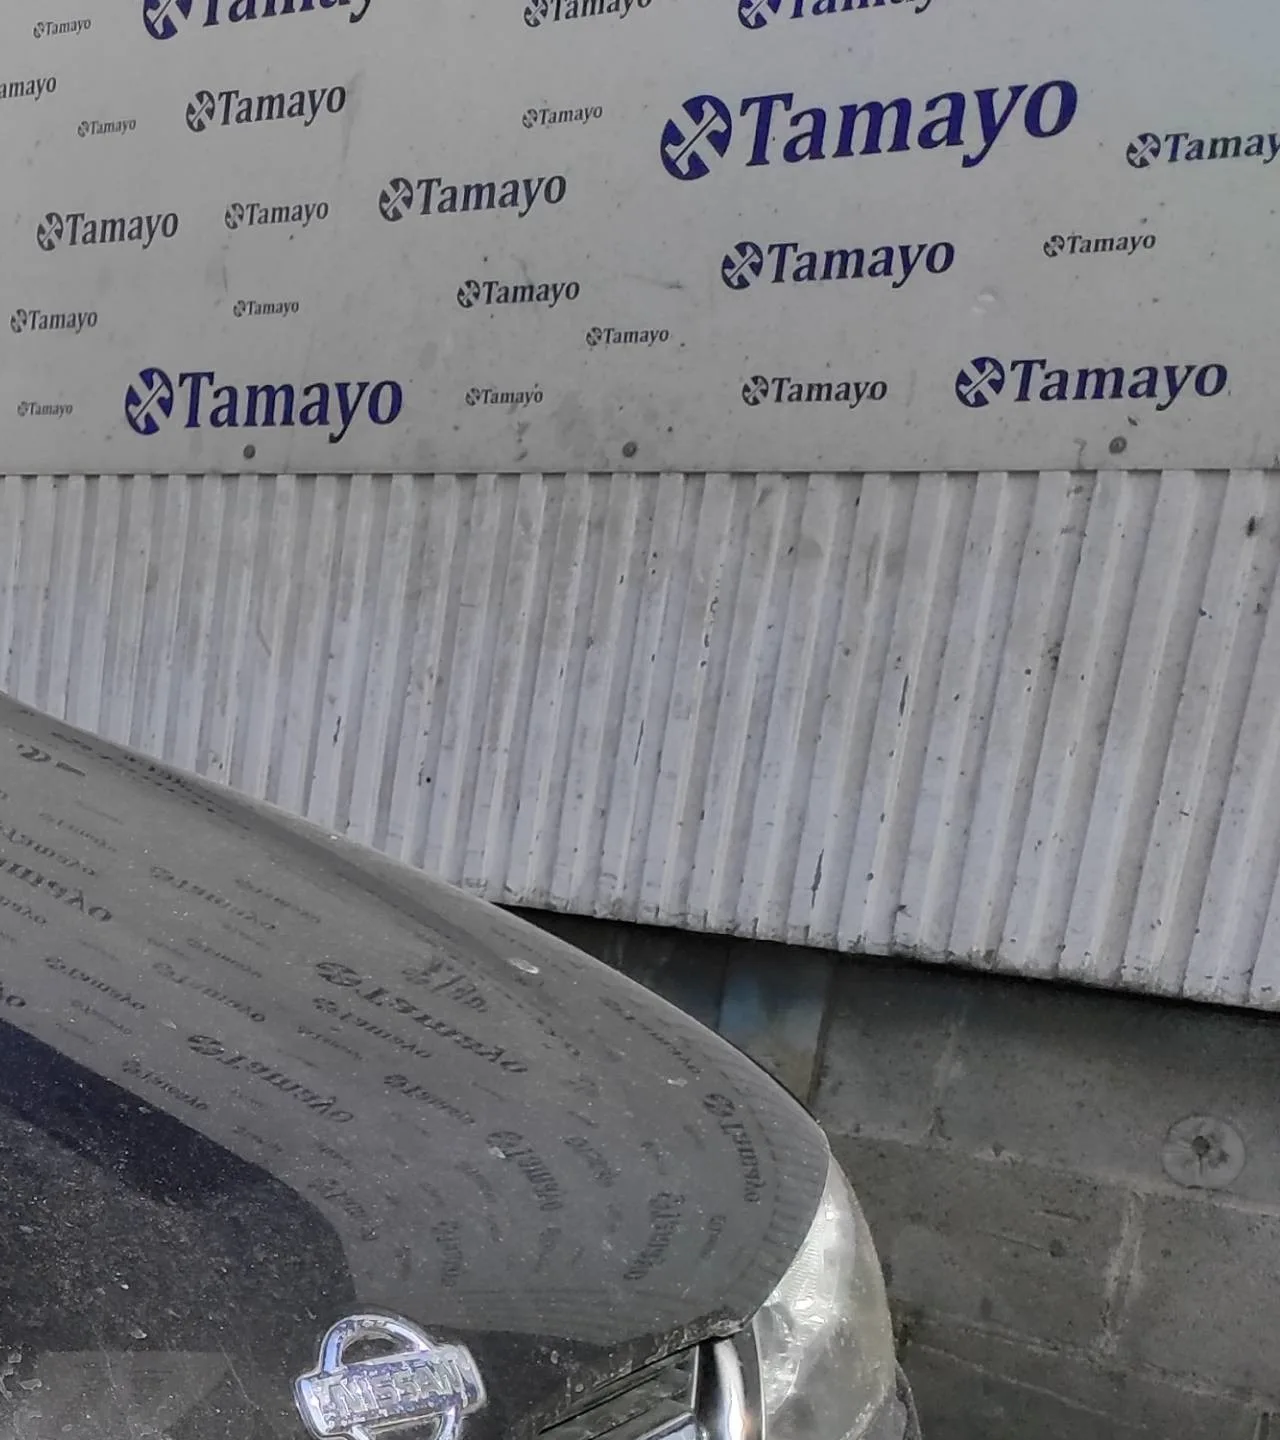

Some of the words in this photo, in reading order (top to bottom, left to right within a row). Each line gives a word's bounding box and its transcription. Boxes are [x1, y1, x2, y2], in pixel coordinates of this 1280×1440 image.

[46, 19, 91, 35] Tamayo
[0, 77, 56, 100] amayo
[218, 87, 346, 127] Tamayo
[538, 104, 603, 126] Tamayo
[92, 120, 136, 135] Tamayo
[740, 80, 1077, 168] Tamayo
[1165, 133, 1280, 164] Tamay
[417, 176, 566, 218] Tamayo
[246, 203, 328, 227] Tamayo
[66, 213, 178, 249] Tamayo
[1067, 231, 1157, 255] Tamayo
[768, 242, 954, 288] Tamayo
[483, 281, 579, 308] Tamayo
[28, 309, 98, 332] Tamayo
[244, 301, 299, 316] Tamayo
[604, 328, 669, 346] Tamayo
[479, 386, 544, 406] Tamayo
[769, 378, 888, 408] Tamayo
[1010, 359, 1227, 411] Tamayo
[29, 402, 73, 416] Tamayo
[178, 371, 403, 443] Tamayo
